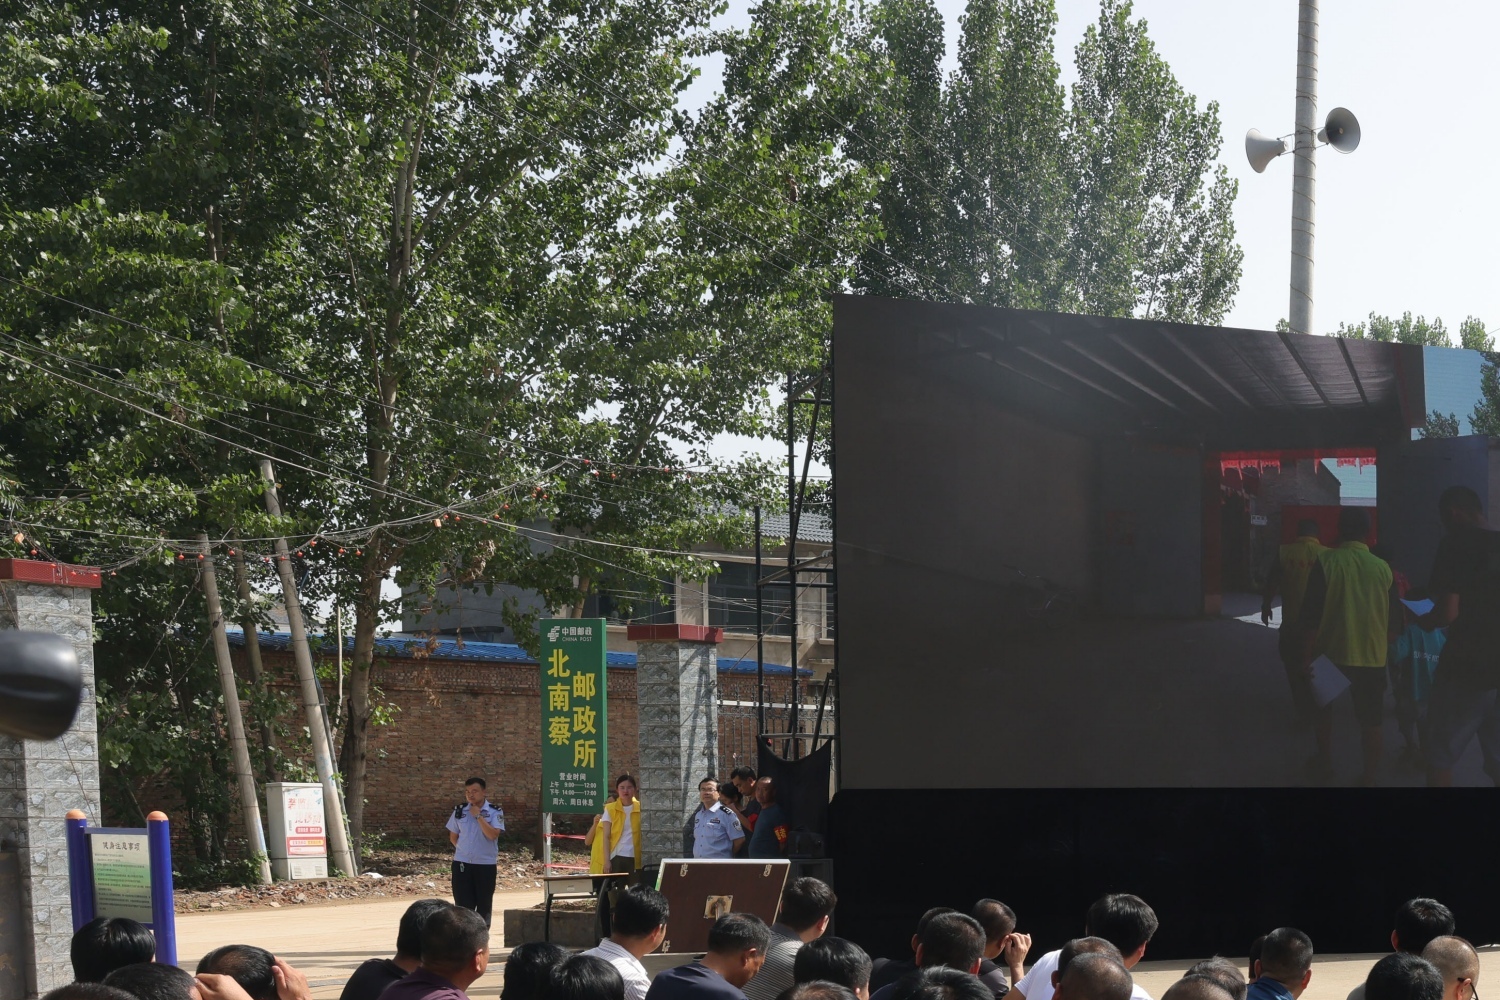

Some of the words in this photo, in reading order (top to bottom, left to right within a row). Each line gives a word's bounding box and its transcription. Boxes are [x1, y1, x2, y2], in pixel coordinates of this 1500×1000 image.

[562, 627, 592, 636] 中国邮政
[547, 649, 571, 745] 北南蔡
[572, 670, 597, 768] 邮政所
[559, 772, 586, 781] 营业时间
